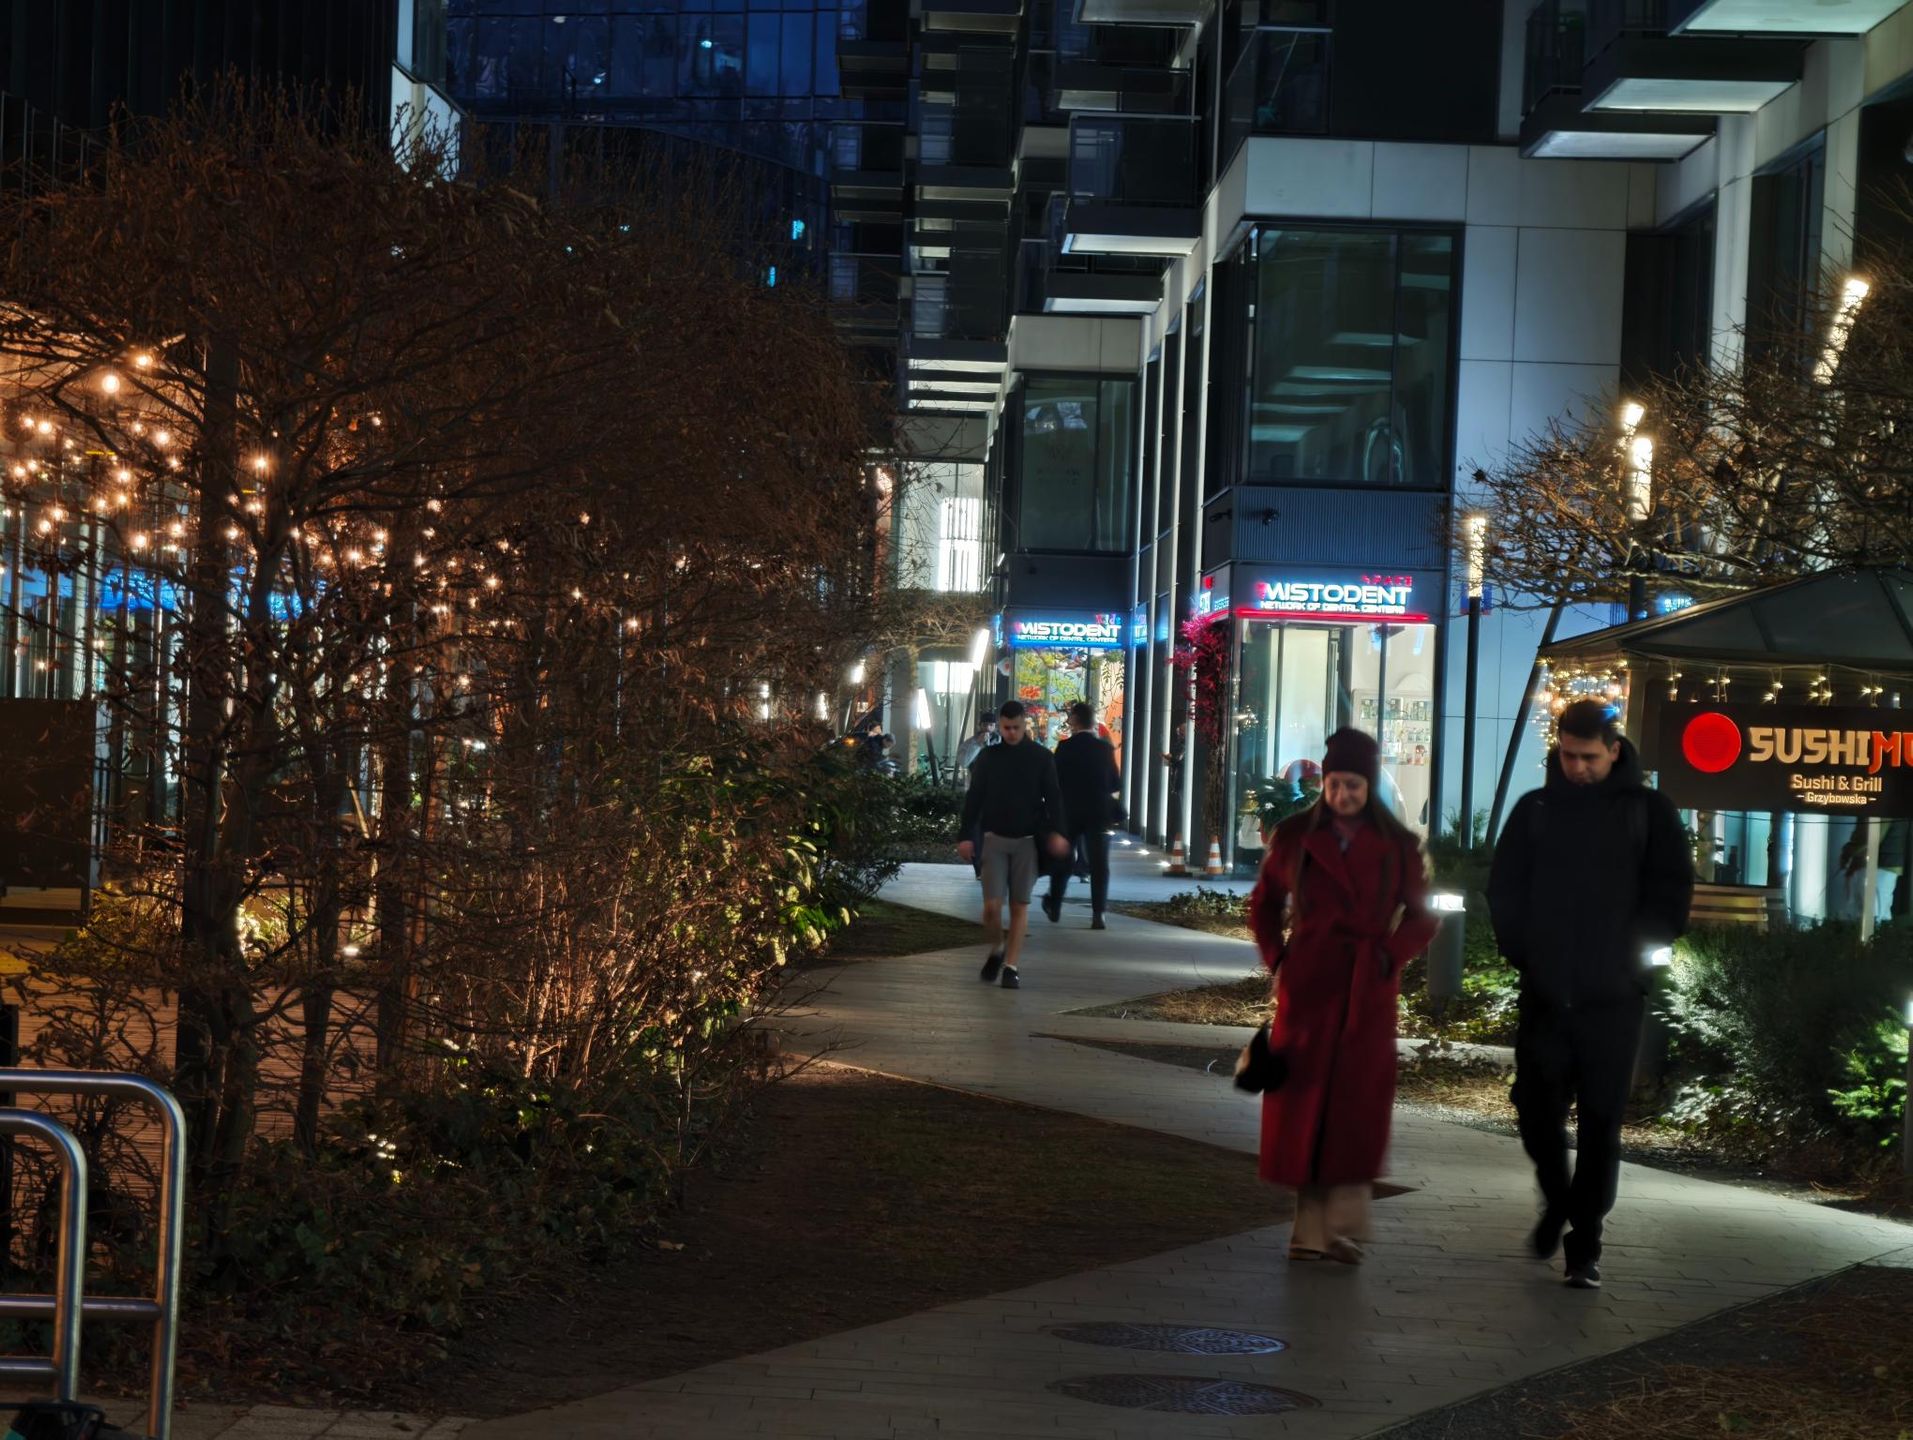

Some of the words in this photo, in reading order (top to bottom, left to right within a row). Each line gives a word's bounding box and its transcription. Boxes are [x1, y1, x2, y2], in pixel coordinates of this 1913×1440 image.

[1256, 582, 1412, 605] MISTODENT
[1014, 621, 1121, 637] MISTODENT
[1792, 774, 1834, 790] Sushi
[1838, 775, 1850, 791] &
[1853, 776, 1882, 792] Grill
[1806, 791, 1867, 805] Grzybowska
